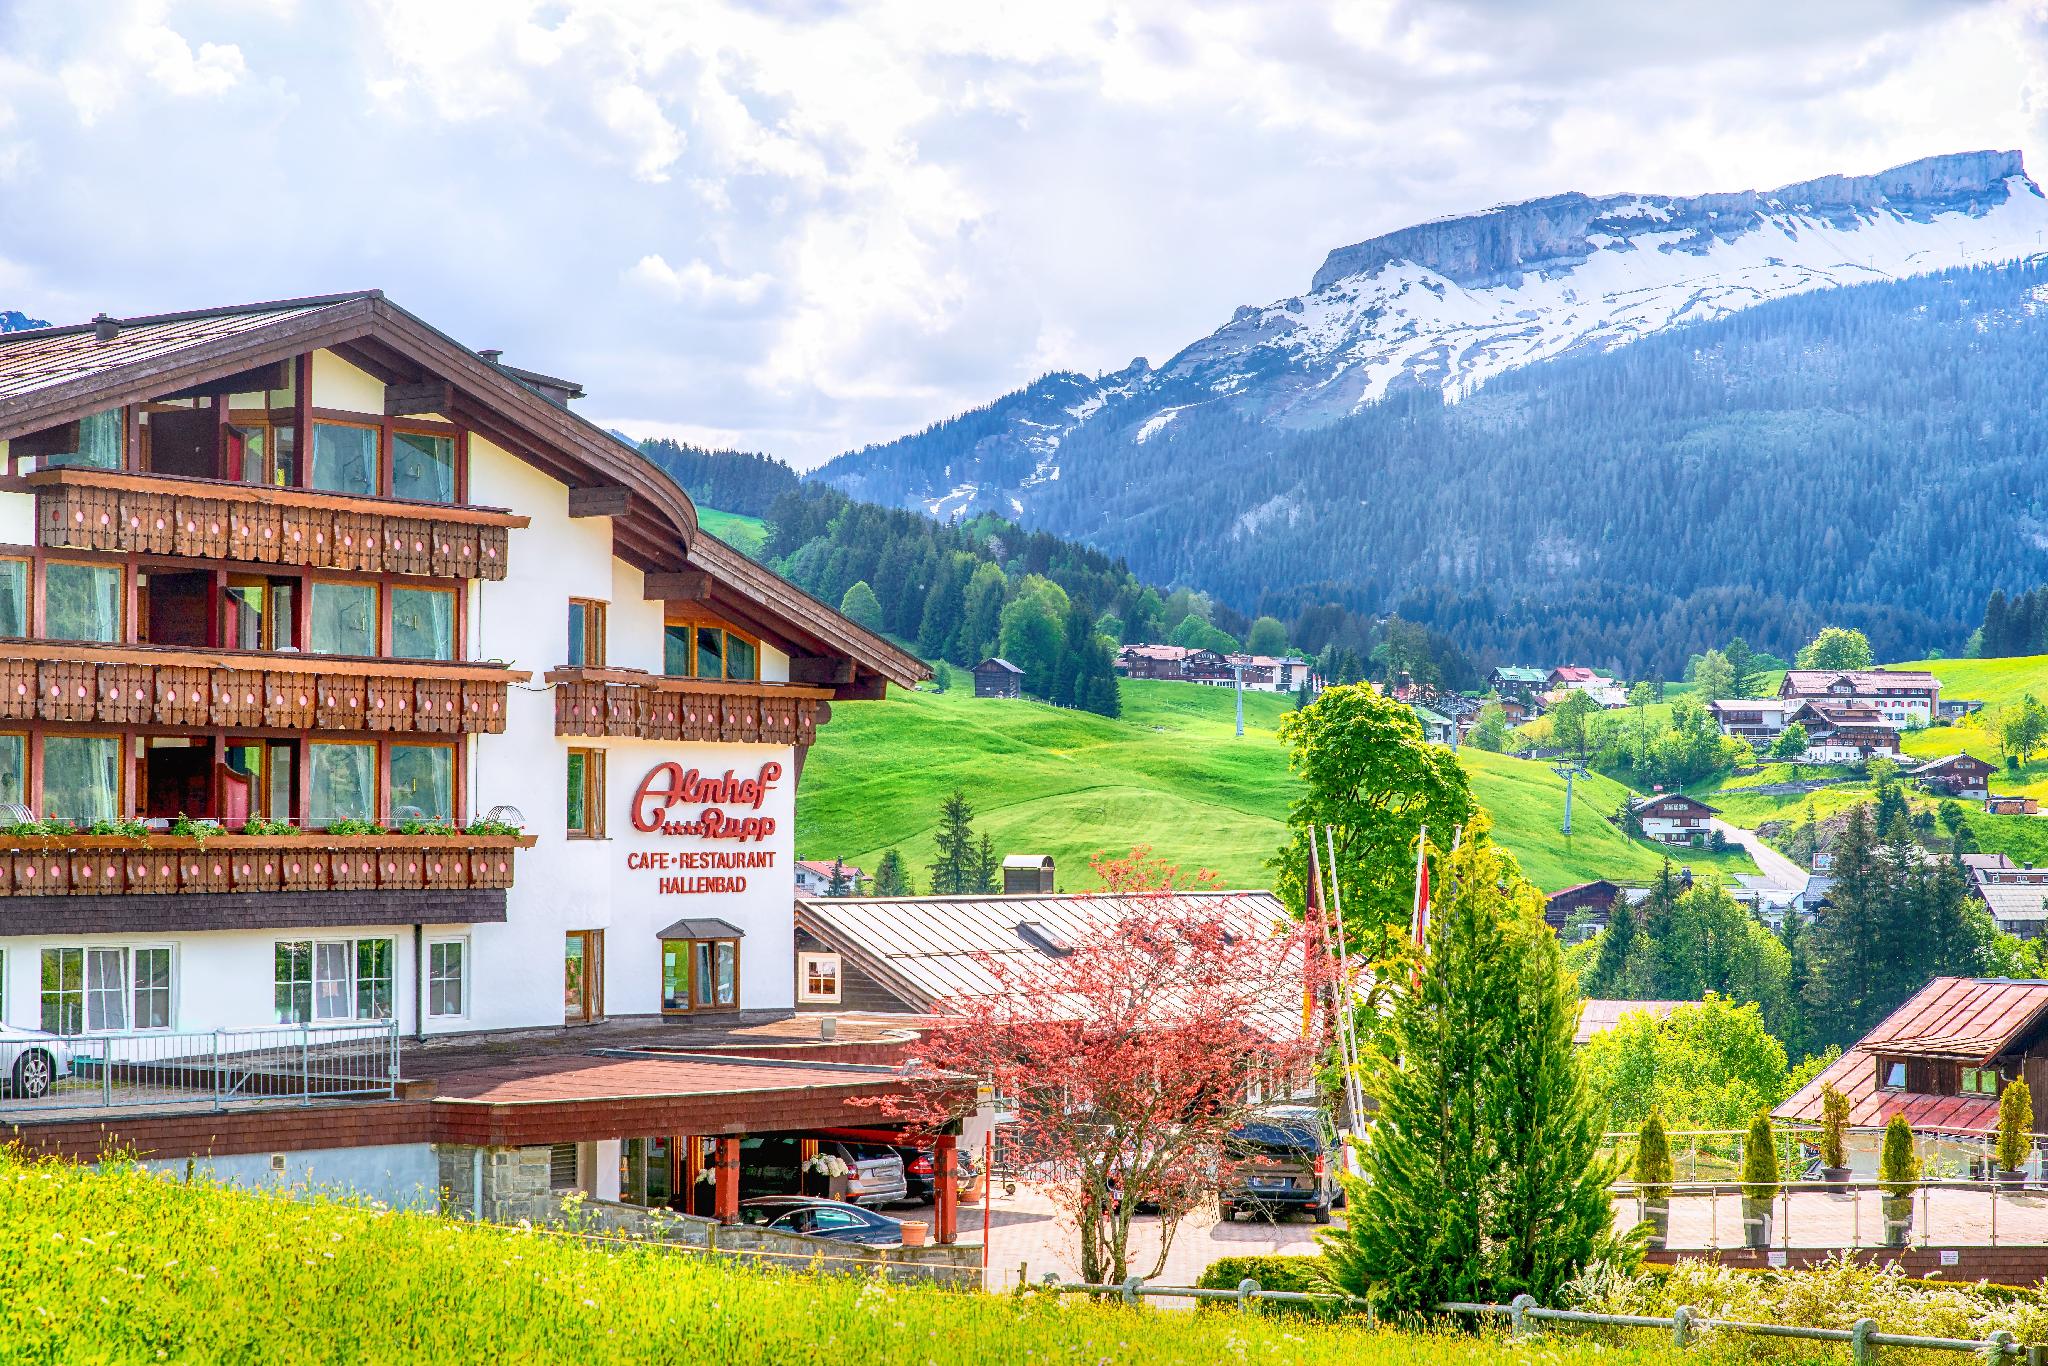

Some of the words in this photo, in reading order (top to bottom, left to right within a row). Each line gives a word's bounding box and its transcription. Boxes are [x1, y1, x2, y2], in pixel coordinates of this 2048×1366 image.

[631, 761, 782, 833] Almhof
[701, 807, 776, 842] Rupp
[659, 876, 747, 894] HALLENBAD
